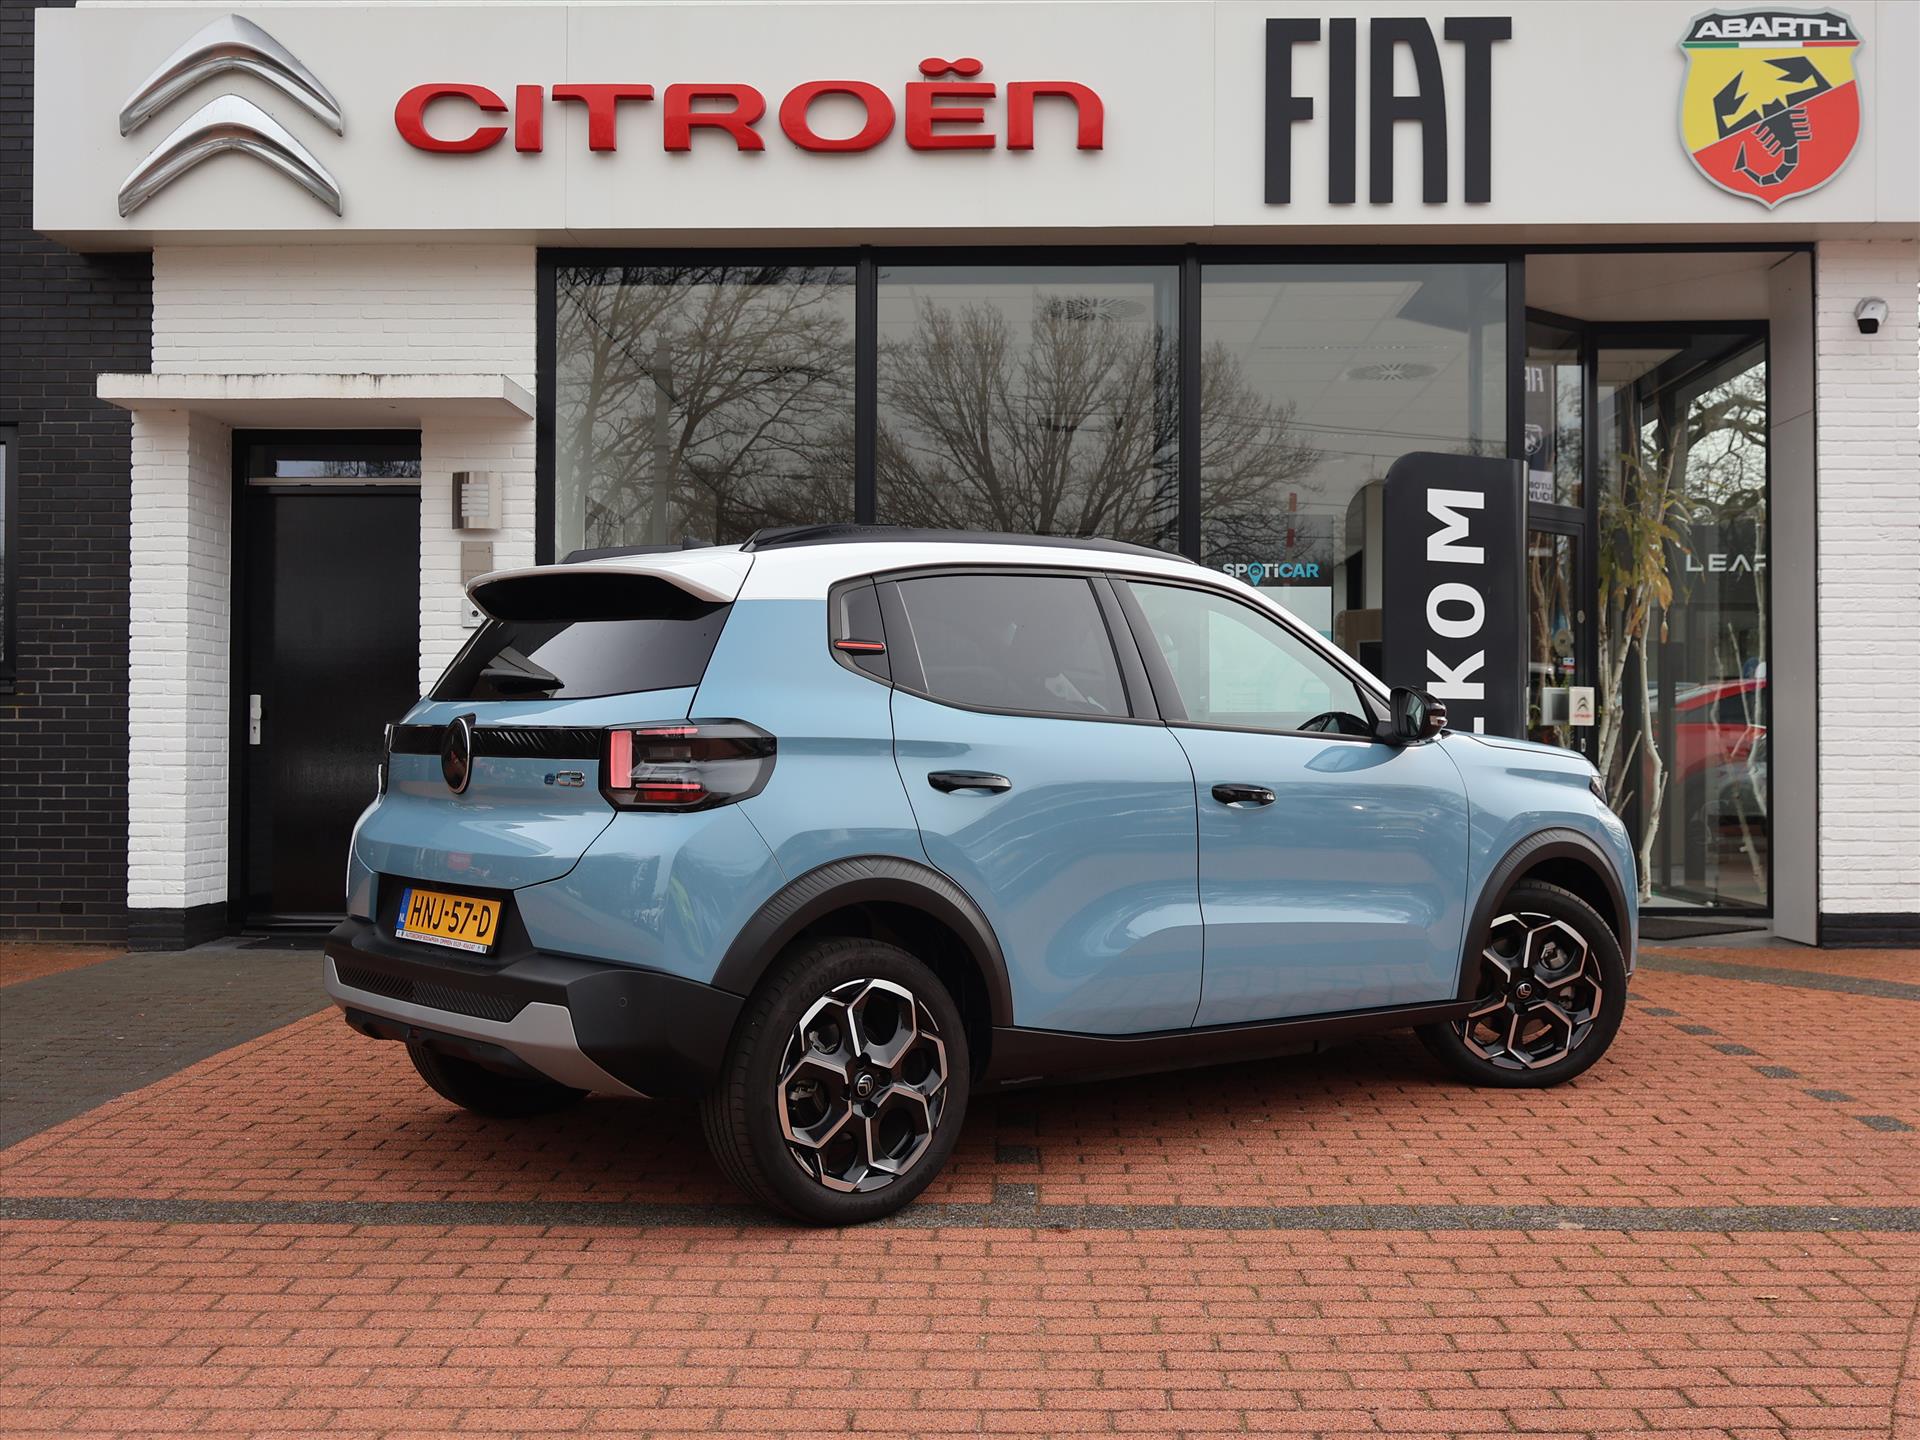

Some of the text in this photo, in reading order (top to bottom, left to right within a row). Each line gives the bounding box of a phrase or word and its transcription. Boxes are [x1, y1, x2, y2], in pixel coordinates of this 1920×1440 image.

[1695, 16, 1847, 38] ABARTH
[1265, 17, 1512, 204] FIAT
[1426, 488, 1486, 735] KOM
[398, 912, 405, 923] NL
[409, 895, 491, 938] HNJ-57-D
